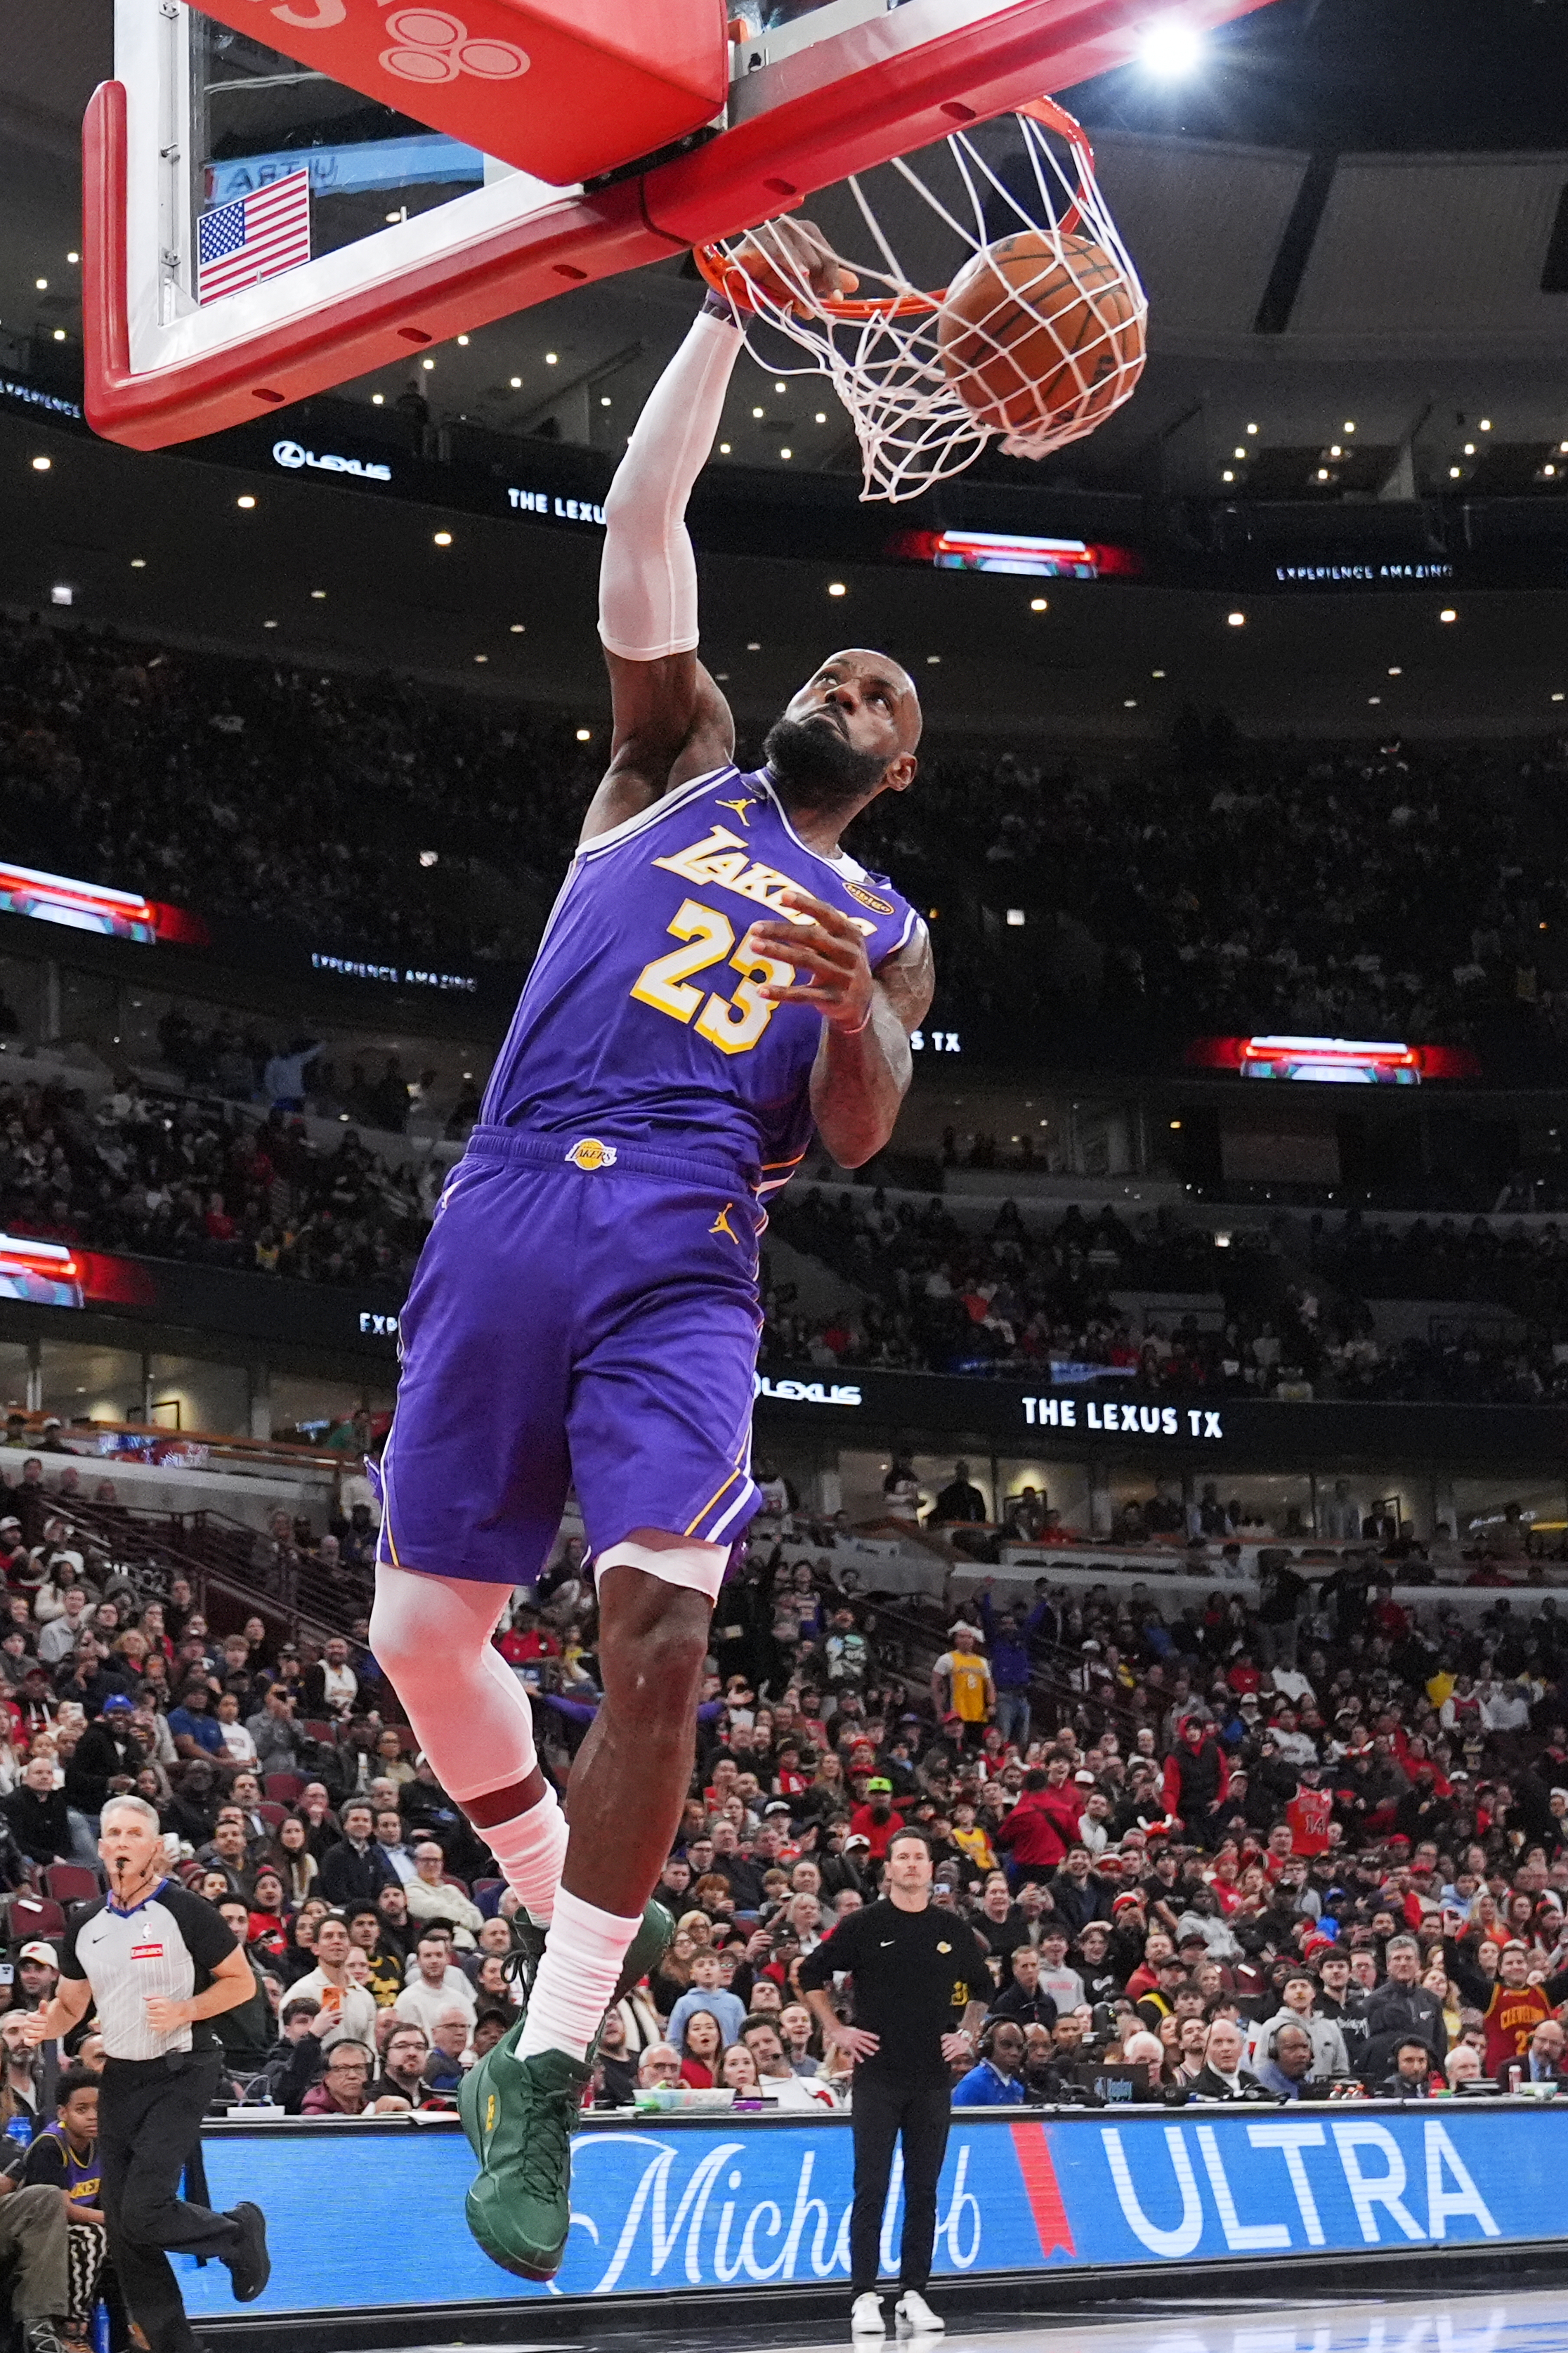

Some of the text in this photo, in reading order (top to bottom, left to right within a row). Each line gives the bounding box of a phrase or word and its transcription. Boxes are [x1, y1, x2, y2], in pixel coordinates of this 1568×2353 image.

[306, 450, 392, 481] LEXUS
[508, 488, 607, 525] THE LEXU
[1276, 565, 1373, 580] EXPERIENCE
[630, 898, 797, 1055] 23
[932, 1031, 961, 1052] TX
[569, 1145, 613, 1164] LAKERS
[762, 1376, 863, 1406] LEXUS
[1021, 1397, 1223, 1439] THE LEXUS TX
[1101, 2120, 1502, 2258] ULTRA
